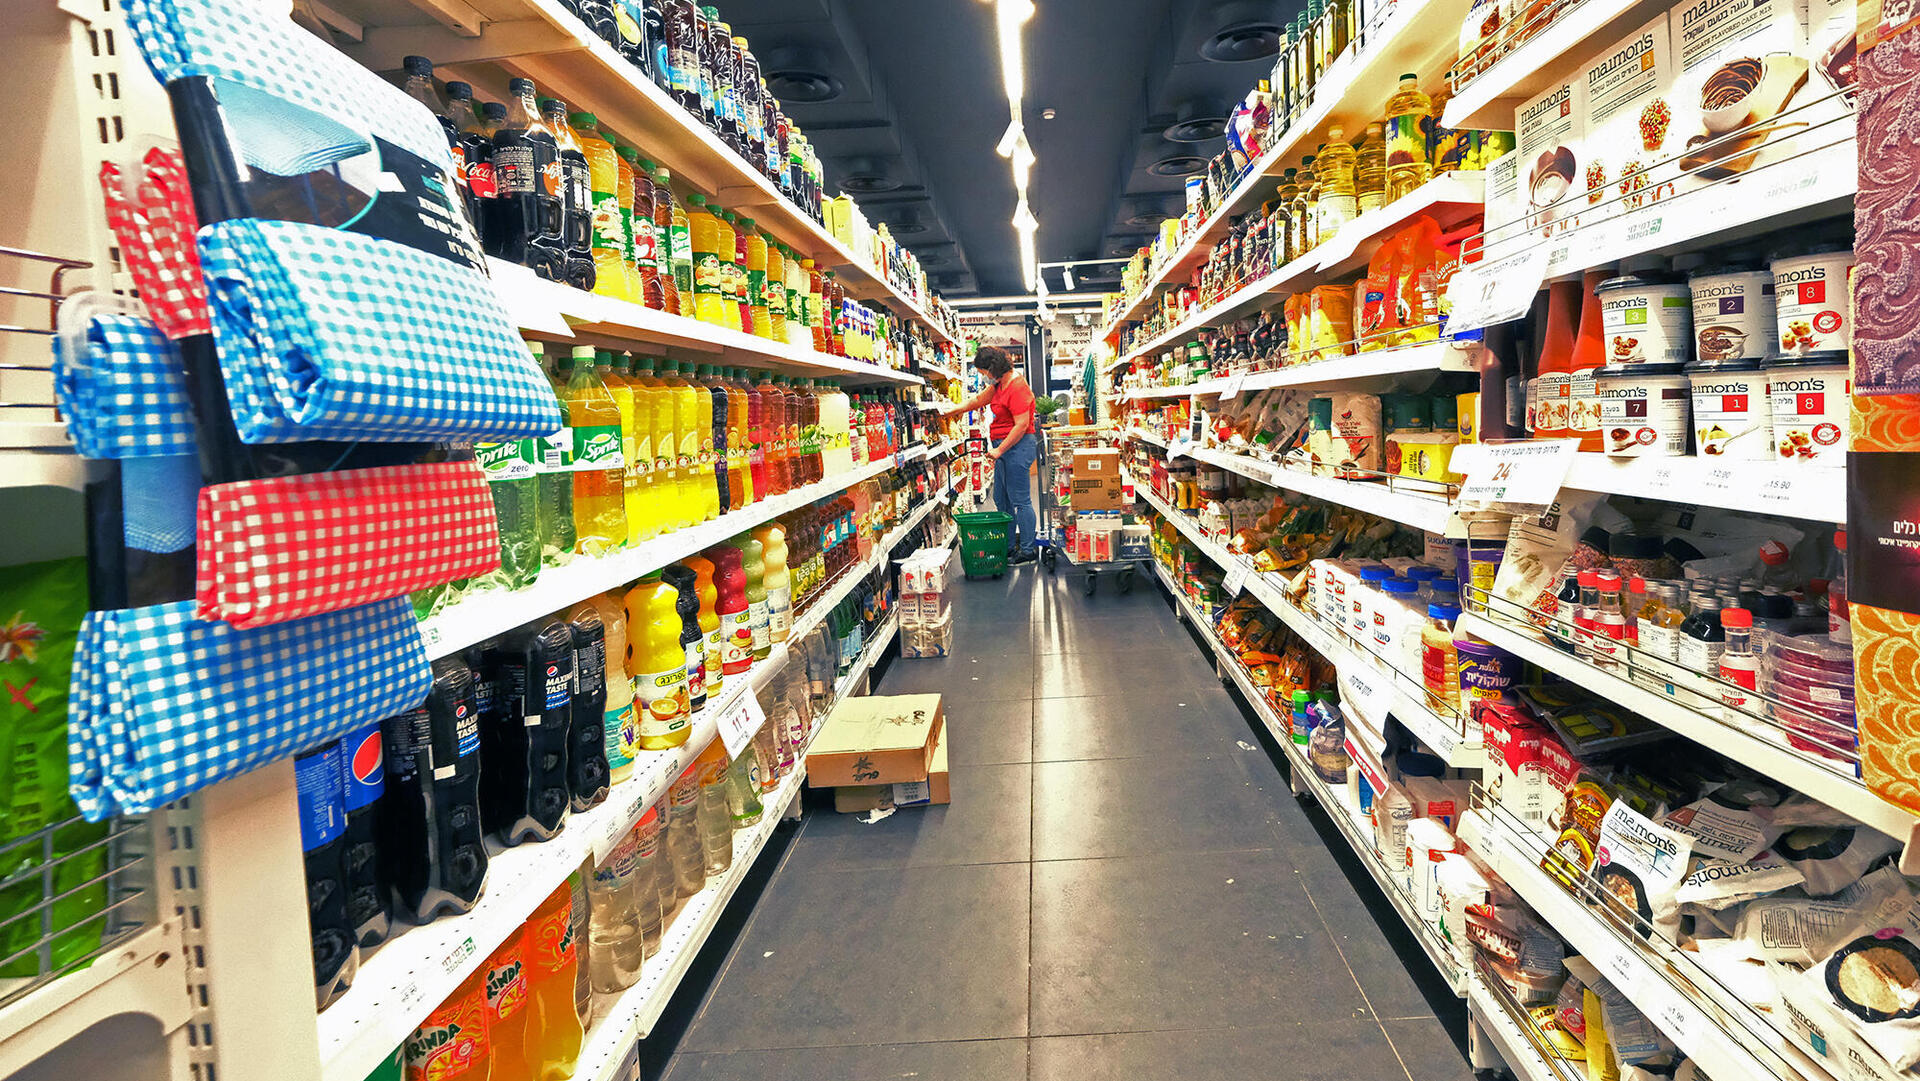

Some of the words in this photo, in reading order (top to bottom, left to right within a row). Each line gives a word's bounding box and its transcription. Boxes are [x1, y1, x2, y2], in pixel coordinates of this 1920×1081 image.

[1682, 38, 1712, 59] CHOCOLATE
[1711, 21, 1742, 42] FLAVORED
[1740, 11, 1760, 25] CAKE
[1758, 4, 1774, 17] MIX
[1588, 32, 1655, 84] maimon's
[1645, 53, 1652, 66] 3
[1521, 84, 1571, 124] maimon's
[1562, 102, 1569, 114] 6
[1480, 281, 1497, 303] 12
[1805, 287, 1816, 298] 8
[1726, 300, 1736, 311] 2
[1631, 310, 1640, 321] 3
[1632, 403, 1641, 413] 7
[1733, 399, 1742, 409] 1
[1804, 397, 1815, 410] 8
[475, 442, 518, 466] Sprite
[510, 462, 530, 474] zero
[1491, 462, 1513, 481] 24
[1549, 515, 1555, 528] 8
[1893, 520, 1916, 535] כלים
[1426, 536, 1453, 545] SUGAR
[1465, 670, 1511, 688] שוקולית
[545, 682, 568, 695] TASTE
